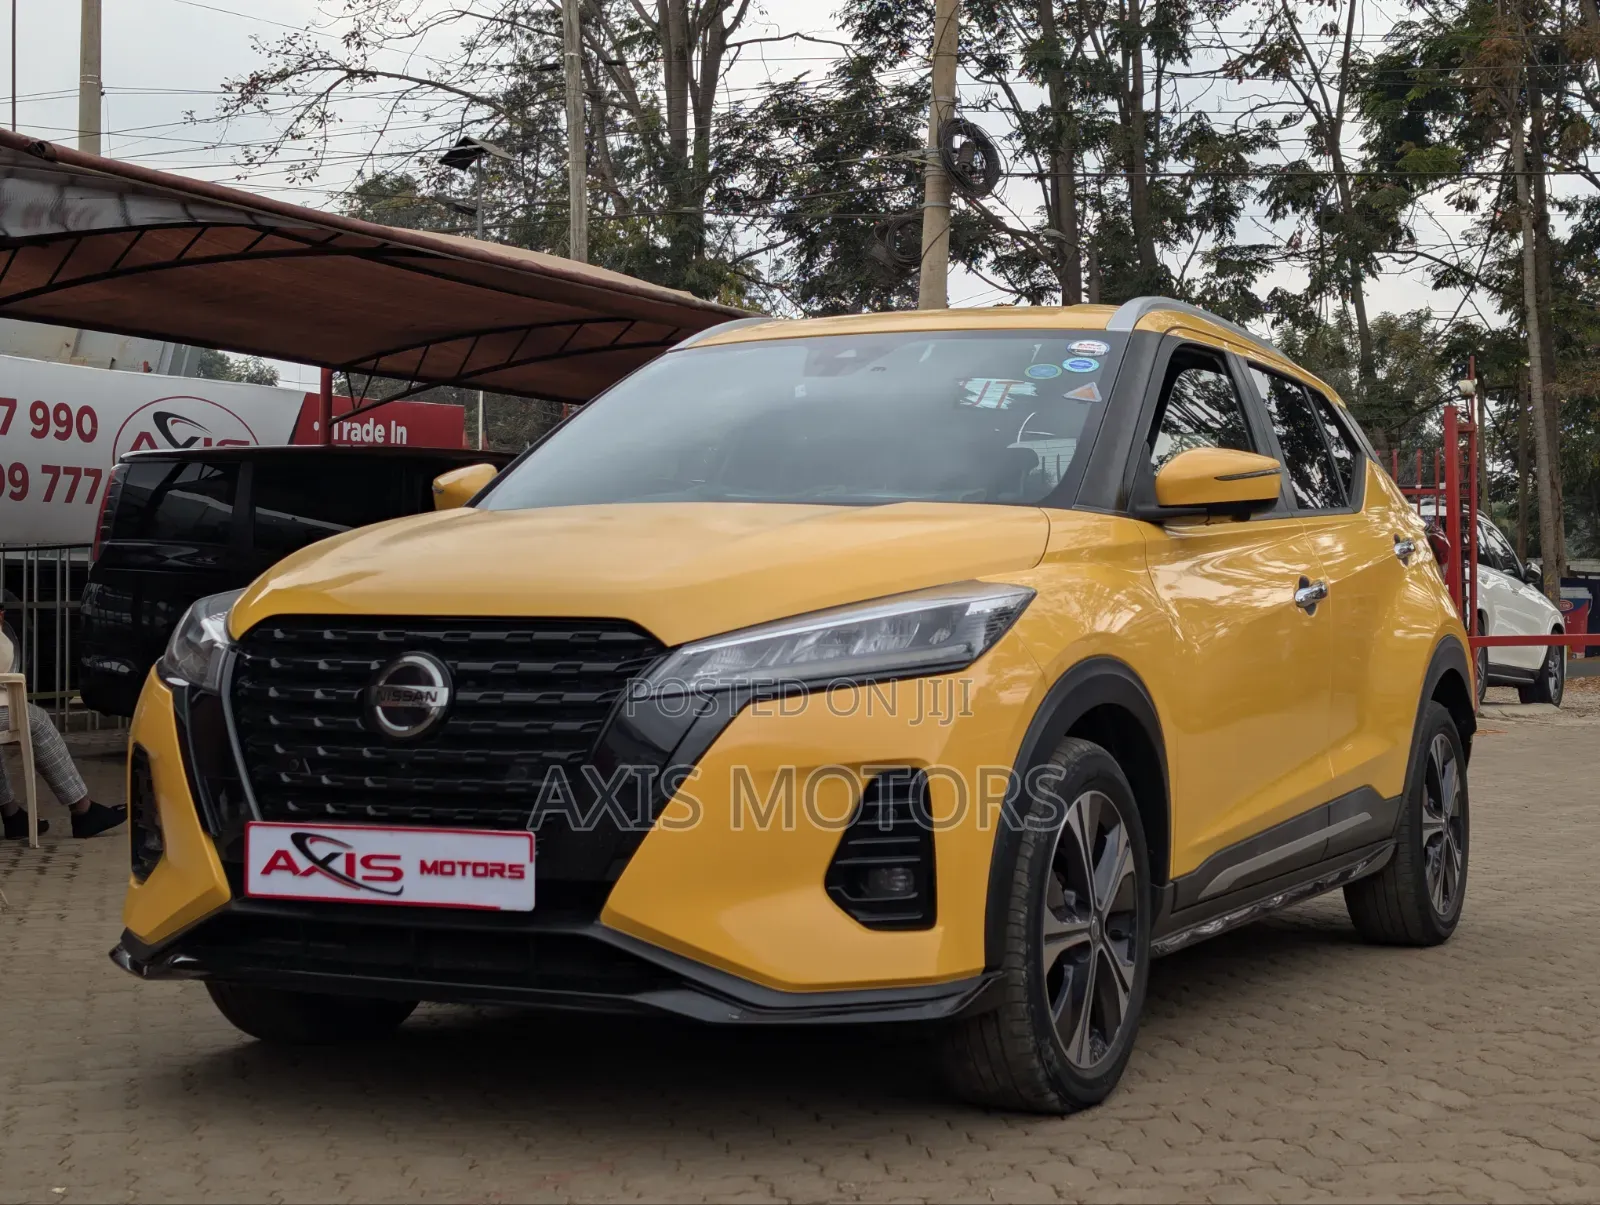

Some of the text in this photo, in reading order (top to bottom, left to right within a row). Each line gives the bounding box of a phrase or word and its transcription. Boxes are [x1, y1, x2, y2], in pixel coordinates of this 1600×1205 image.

[29, 400, 98, 443] 990
[332, 416, 407, 445] Trade In
[0, 462, 103, 505] 9 777
[377, 689, 438, 702] NISSAN
[260, 835, 525, 893] AXIS MOTORS
